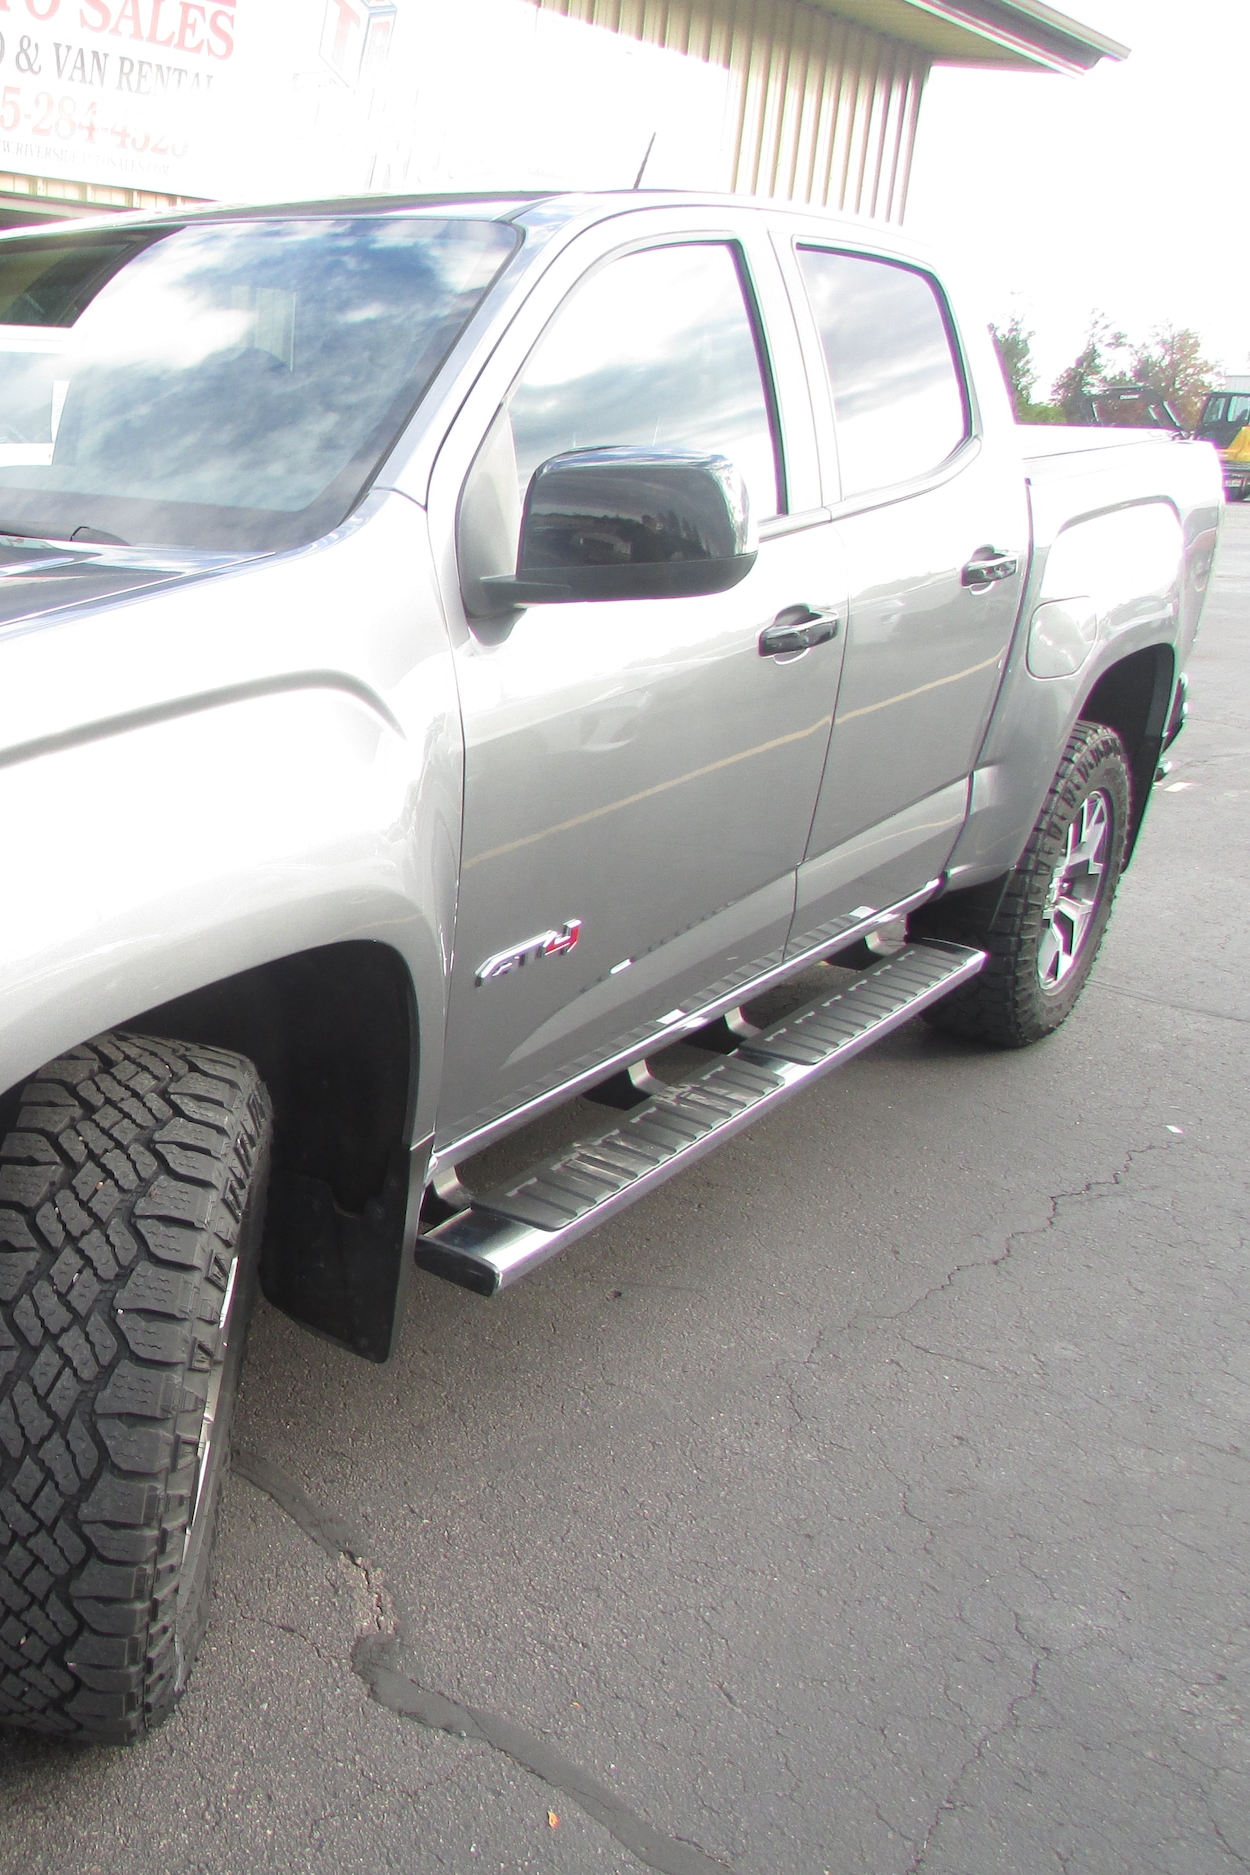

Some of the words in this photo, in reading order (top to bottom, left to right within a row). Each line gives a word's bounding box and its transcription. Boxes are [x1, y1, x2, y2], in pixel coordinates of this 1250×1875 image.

[79, 0, 235, 61] SALES
[15, 34, 42, 76] &
[53, 41, 110, 90] VAN
